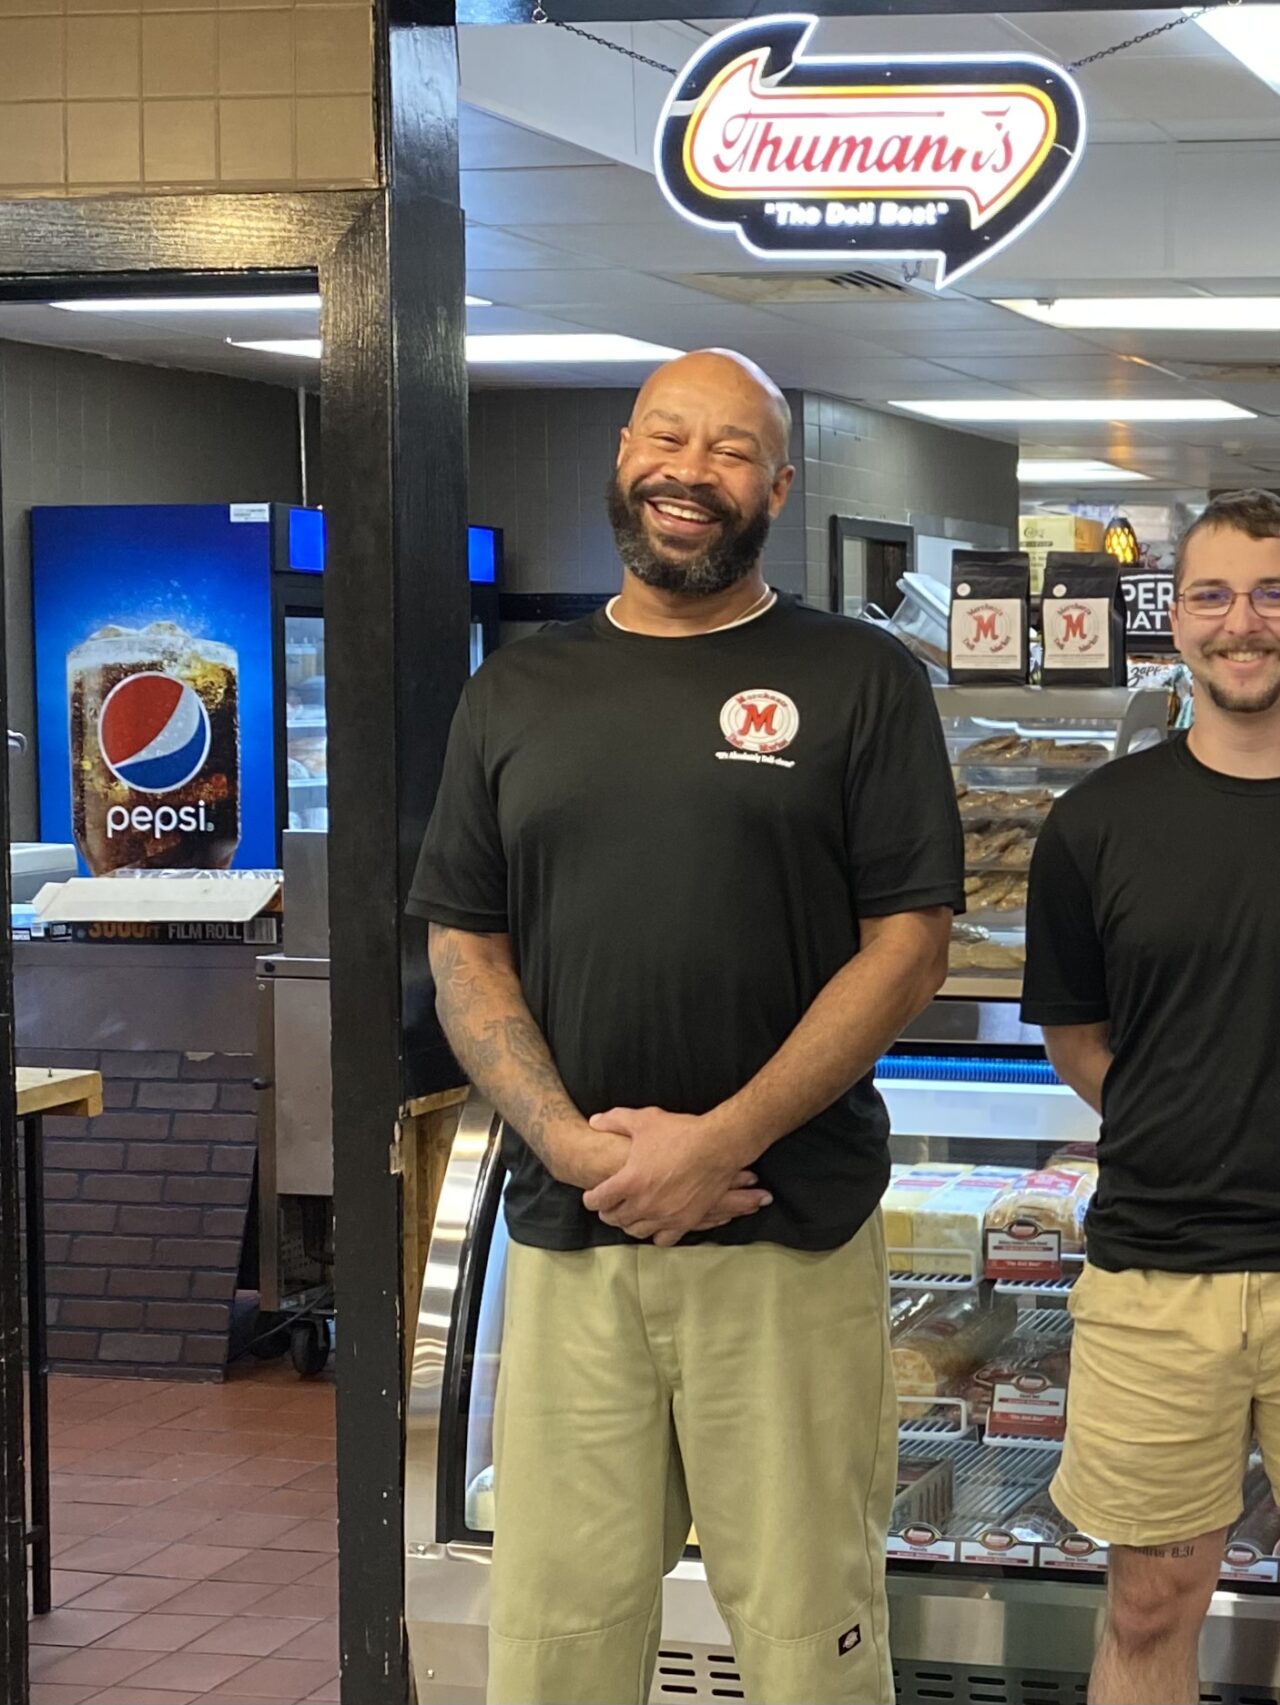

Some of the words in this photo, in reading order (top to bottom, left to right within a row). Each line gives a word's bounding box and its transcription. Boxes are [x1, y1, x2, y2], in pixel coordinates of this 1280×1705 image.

[738, 703, 778, 736] M
[106, 800, 208, 838] pepsi
[168, 923, 201, 940] FILM
[204, 922, 242, 940] ROLL
